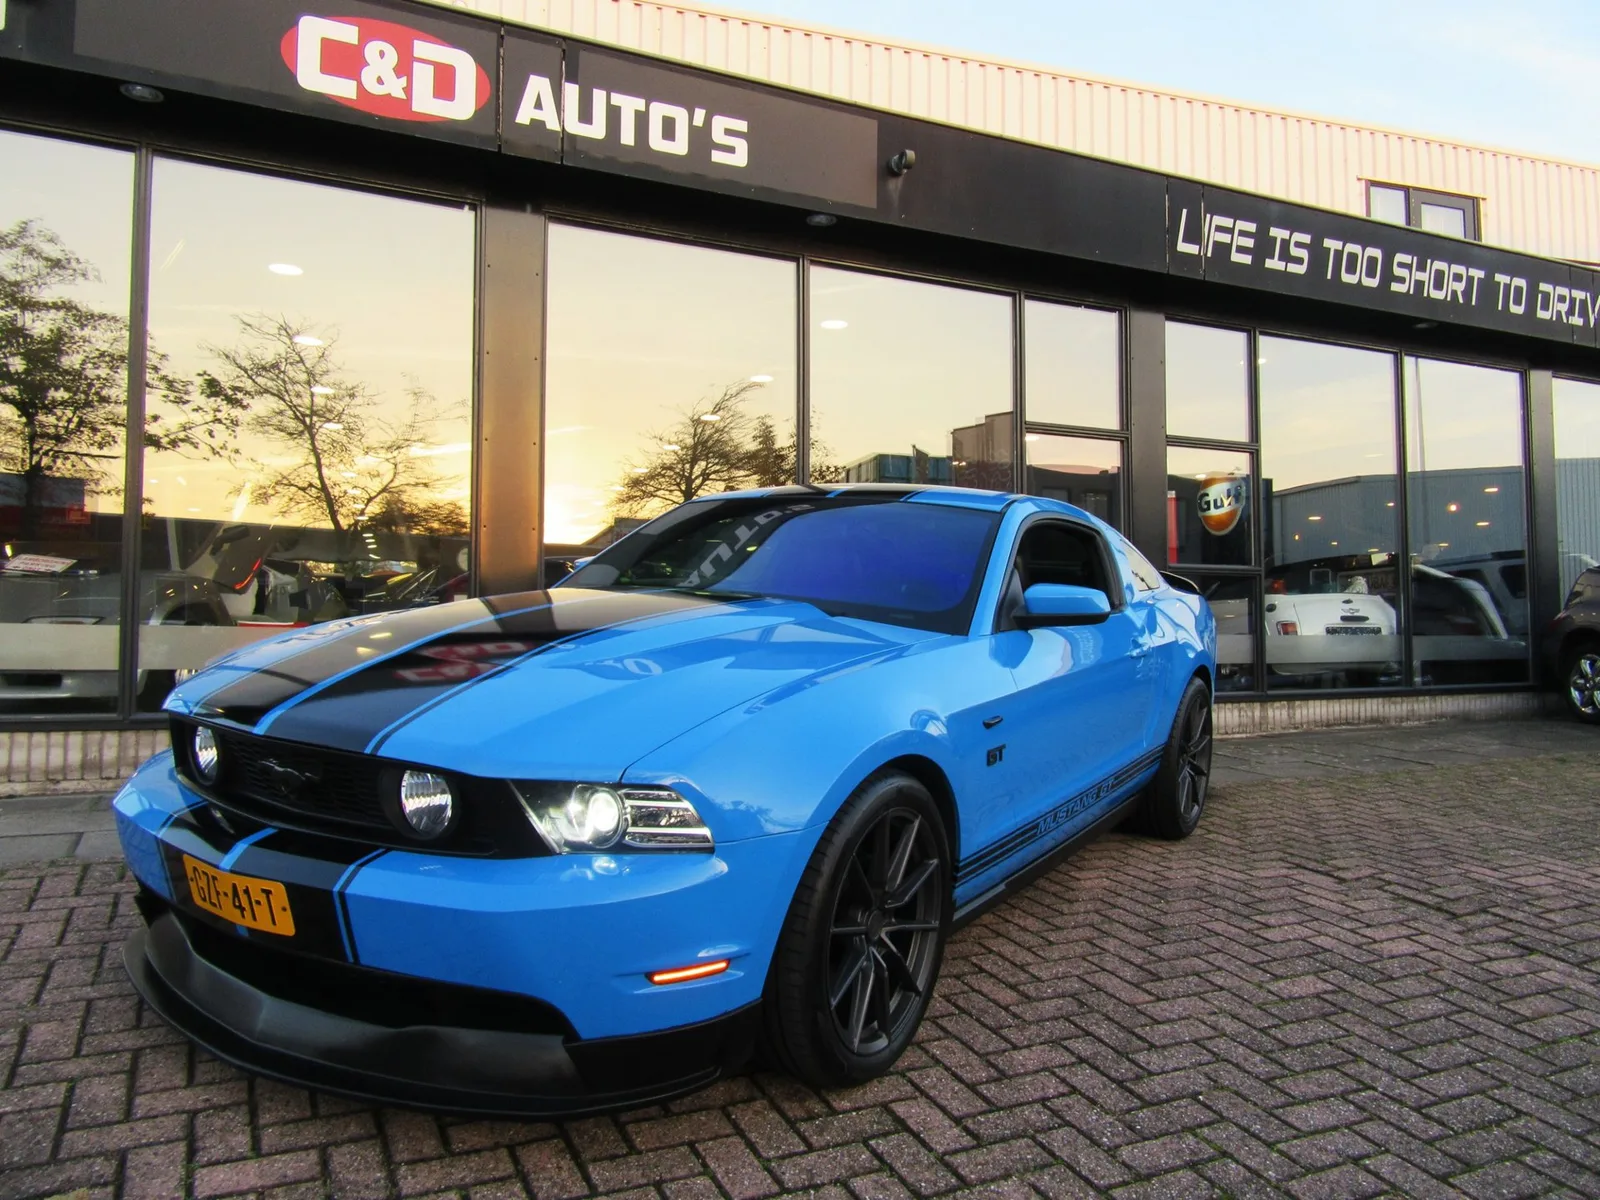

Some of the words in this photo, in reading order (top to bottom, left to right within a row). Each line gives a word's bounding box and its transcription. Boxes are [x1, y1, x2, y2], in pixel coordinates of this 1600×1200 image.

[296, 15, 477, 121] C&D
[515, 74, 748, 168] AUTO'S
[1176, 208, 1257, 265] LIFE
[1264, 226, 1312, 275] IS
[1322, 237, 1383, 288] TOO
[1390, 252, 1485, 306] SHORT
[1494, 272, 1527, 315] TO
[986, 743, 1007, 767] GT
[1036, 790, 1098, 836] MUSTANG
[1099, 778, 1115, 798] GT
[192, 866, 277, 926] GZF-41-T
